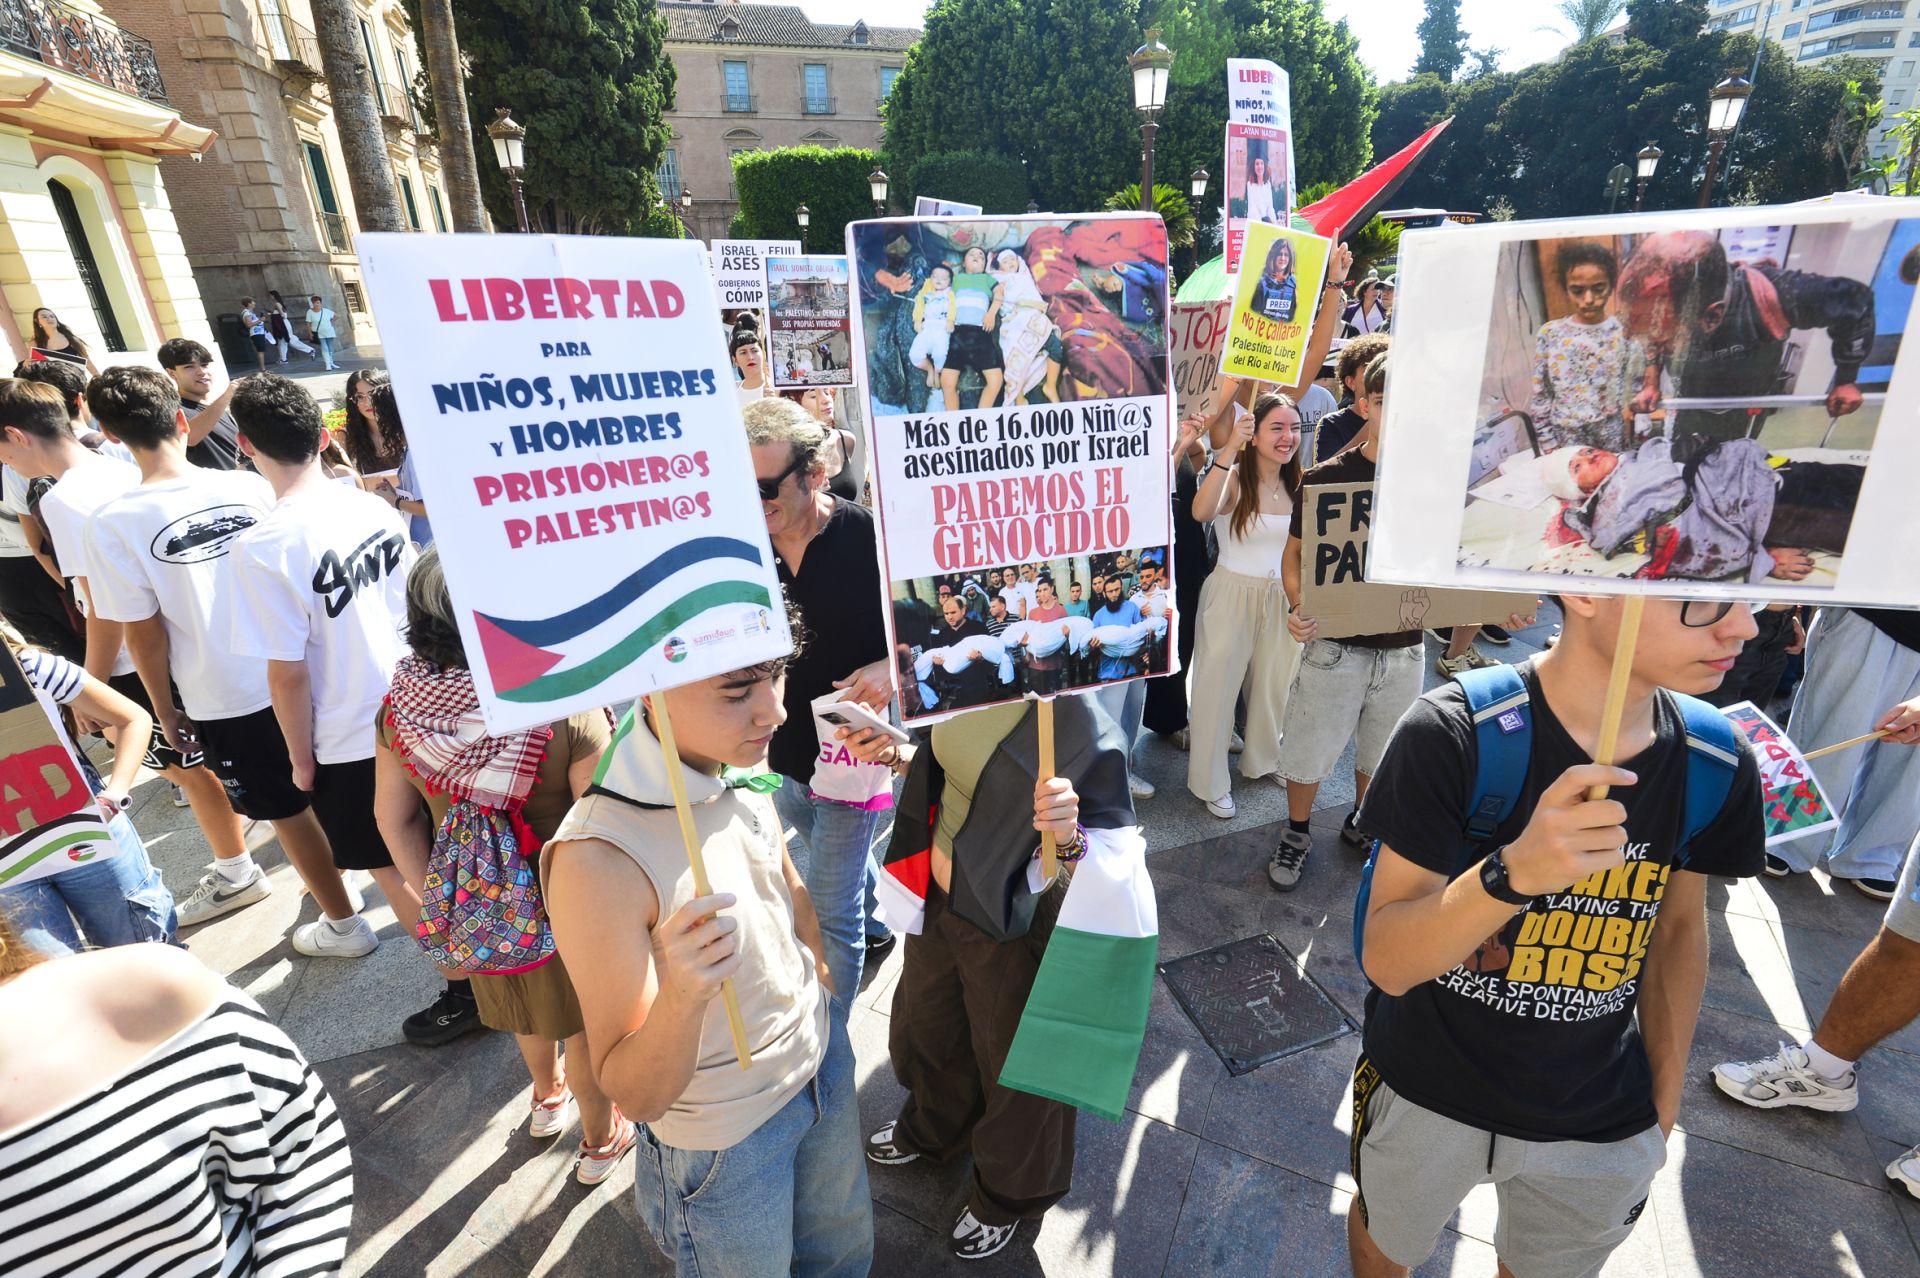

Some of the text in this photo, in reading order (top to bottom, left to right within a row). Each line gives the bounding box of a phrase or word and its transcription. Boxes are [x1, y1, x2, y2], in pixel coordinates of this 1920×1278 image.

[721, 245, 757, 256] ISRAEL
[722, 257, 760, 271] ASES
[718, 280, 761, 288] GOBIERNOS
[725, 287, 763, 303] CÓMP
[428, 277, 685, 322] LIBERTAD
[1269, 301, 1289, 309] PRESS
[781, 320, 841, 328] SUS PROPIAS VIVIENDAS
[785, 309, 815, 317] PALESTINOS
[1242, 312, 1255, 331] No
[1255, 317, 1266, 337] te
[540, 342, 592, 358] PARA
[1232, 337, 1296, 360] Palestina Libre
[1233, 354, 1245, 366] del
[1263, 361, 1270, 369] al
[1271, 360, 1290, 373] Mar
[431, 368, 717, 415] NIÑOS, MUJERES
[510, 412, 683, 454] HOMBRES
[904, 416, 950, 449] Más
[958, 416, 988, 444] de
[995, 408, 1075, 441] 16.000
[1082, 403, 1152, 435] Niñ@s
[904, 430, 1149, 479] asesinados por Israel
[474, 450, 710, 507] PRISIONER@S
[931, 466, 1129, 526] PAREMOS EL
[504, 491, 712, 549] PALESTIN@S
[933, 506, 1130, 571] GENOCIDIO
[1629, 901, 1660, 919] THE
[1506, 946, 1647, 992] BASS
[1435, 971, 1625, 1022] CREATIVE DECISIONS
[1506, 980, 1636, 1007] SPONTANEOUS
